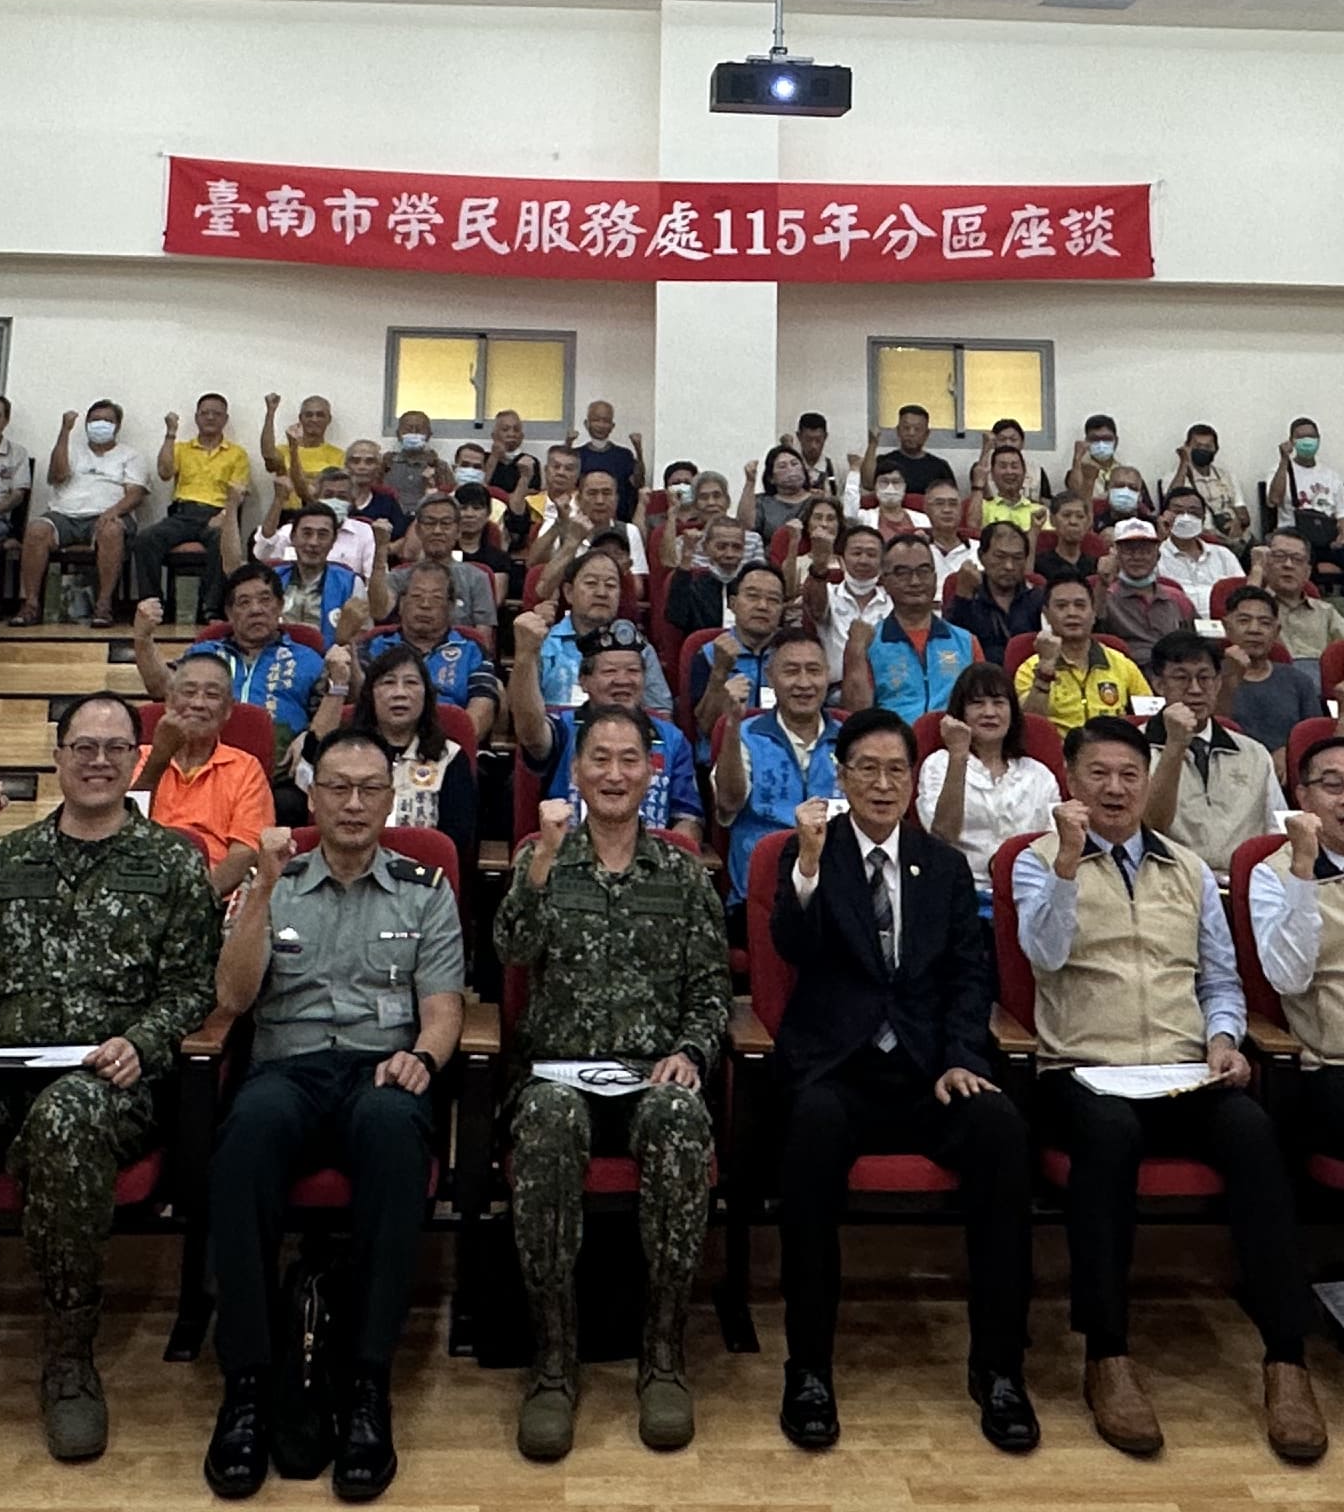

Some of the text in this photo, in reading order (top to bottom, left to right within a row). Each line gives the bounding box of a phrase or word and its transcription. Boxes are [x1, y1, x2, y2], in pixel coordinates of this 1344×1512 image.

[193, 178, 1121, 262] 臺南市榮民服務處115年分區座談
